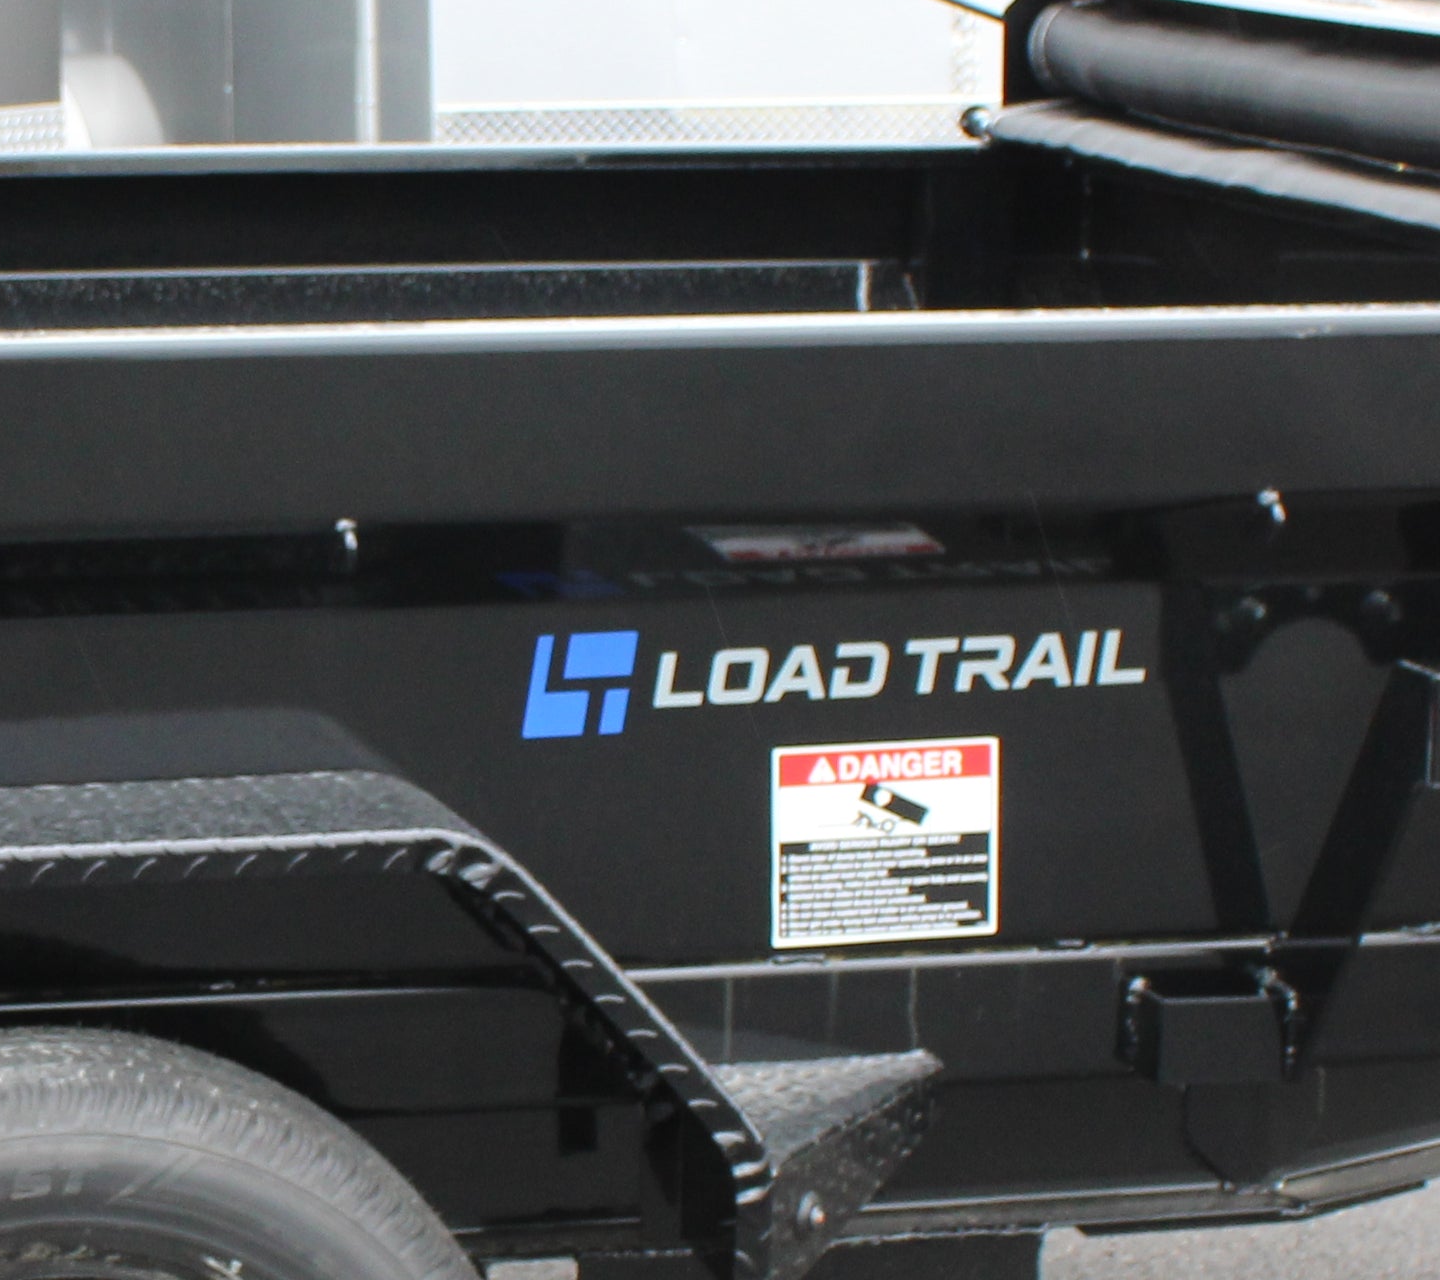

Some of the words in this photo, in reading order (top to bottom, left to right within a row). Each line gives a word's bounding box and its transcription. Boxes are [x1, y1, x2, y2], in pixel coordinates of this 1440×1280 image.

[652, 642, 890, 708] LOAD
[905, 629, 1147, 695] TRAIL
[837, 749, 963, 781] DANGER
